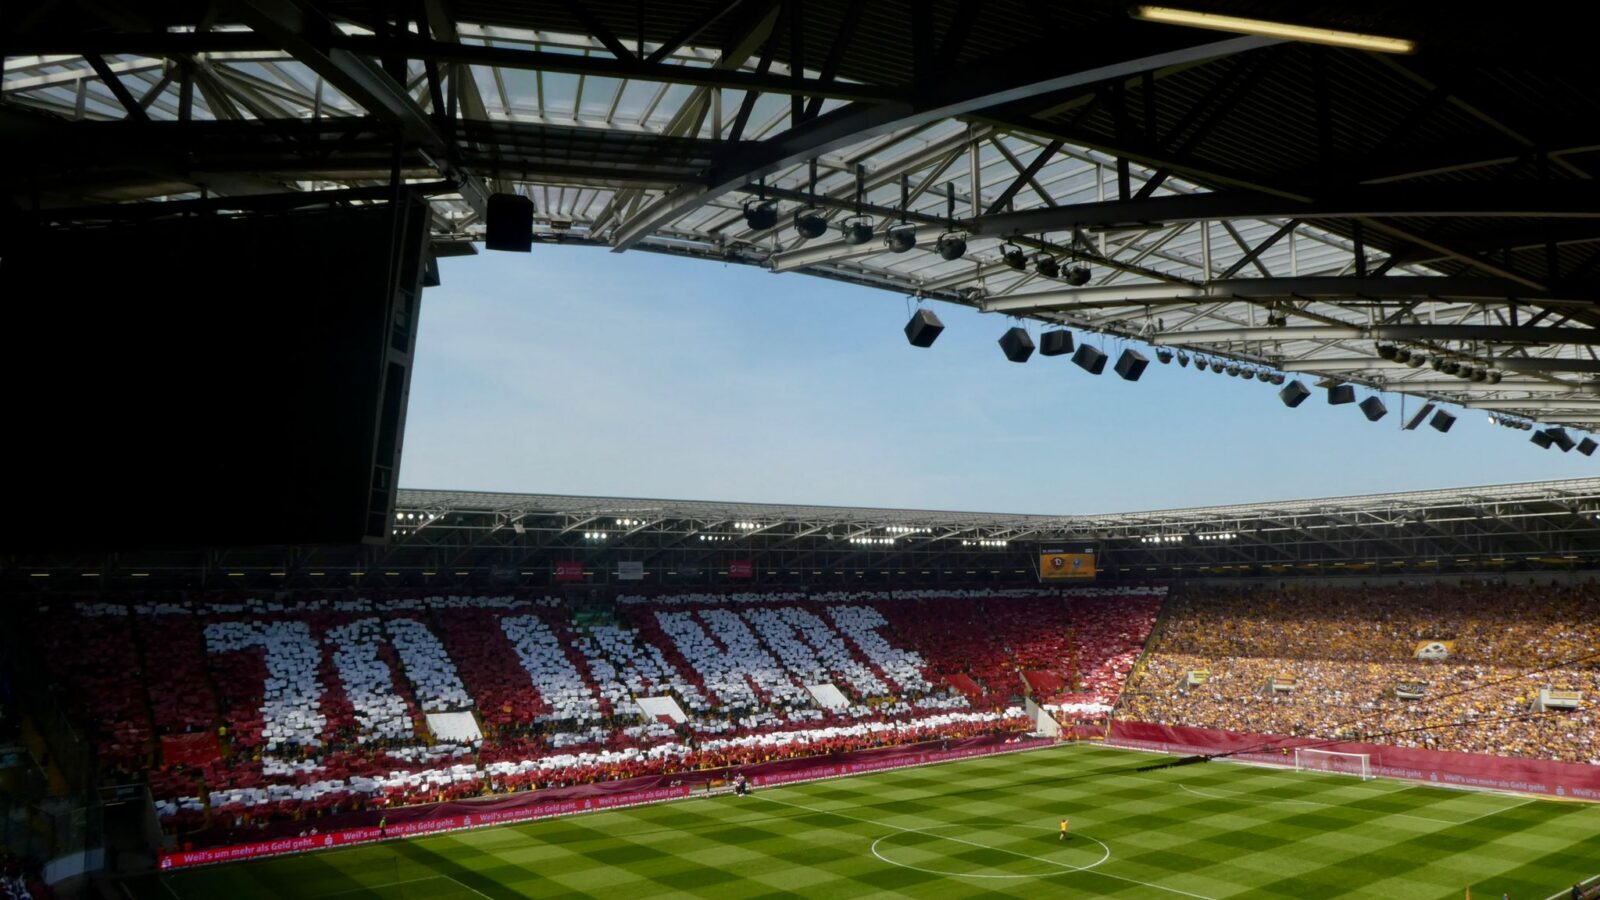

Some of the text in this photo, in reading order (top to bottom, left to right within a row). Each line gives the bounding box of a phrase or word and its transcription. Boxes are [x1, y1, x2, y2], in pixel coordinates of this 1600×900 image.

[343, 831, 368, 840] Weil's
[386, 826, 403, 834] mehr
[405, 824, 416, 832] als
[418, 820, 435, 830] Geld
[184, 852, 212, 863] Weil's
[231, 847, 254, 856] mehr
[256, 844, 269, 852] als
[271, 840, 290, 850] Geld
[292, 839, 314, 849] geht.
